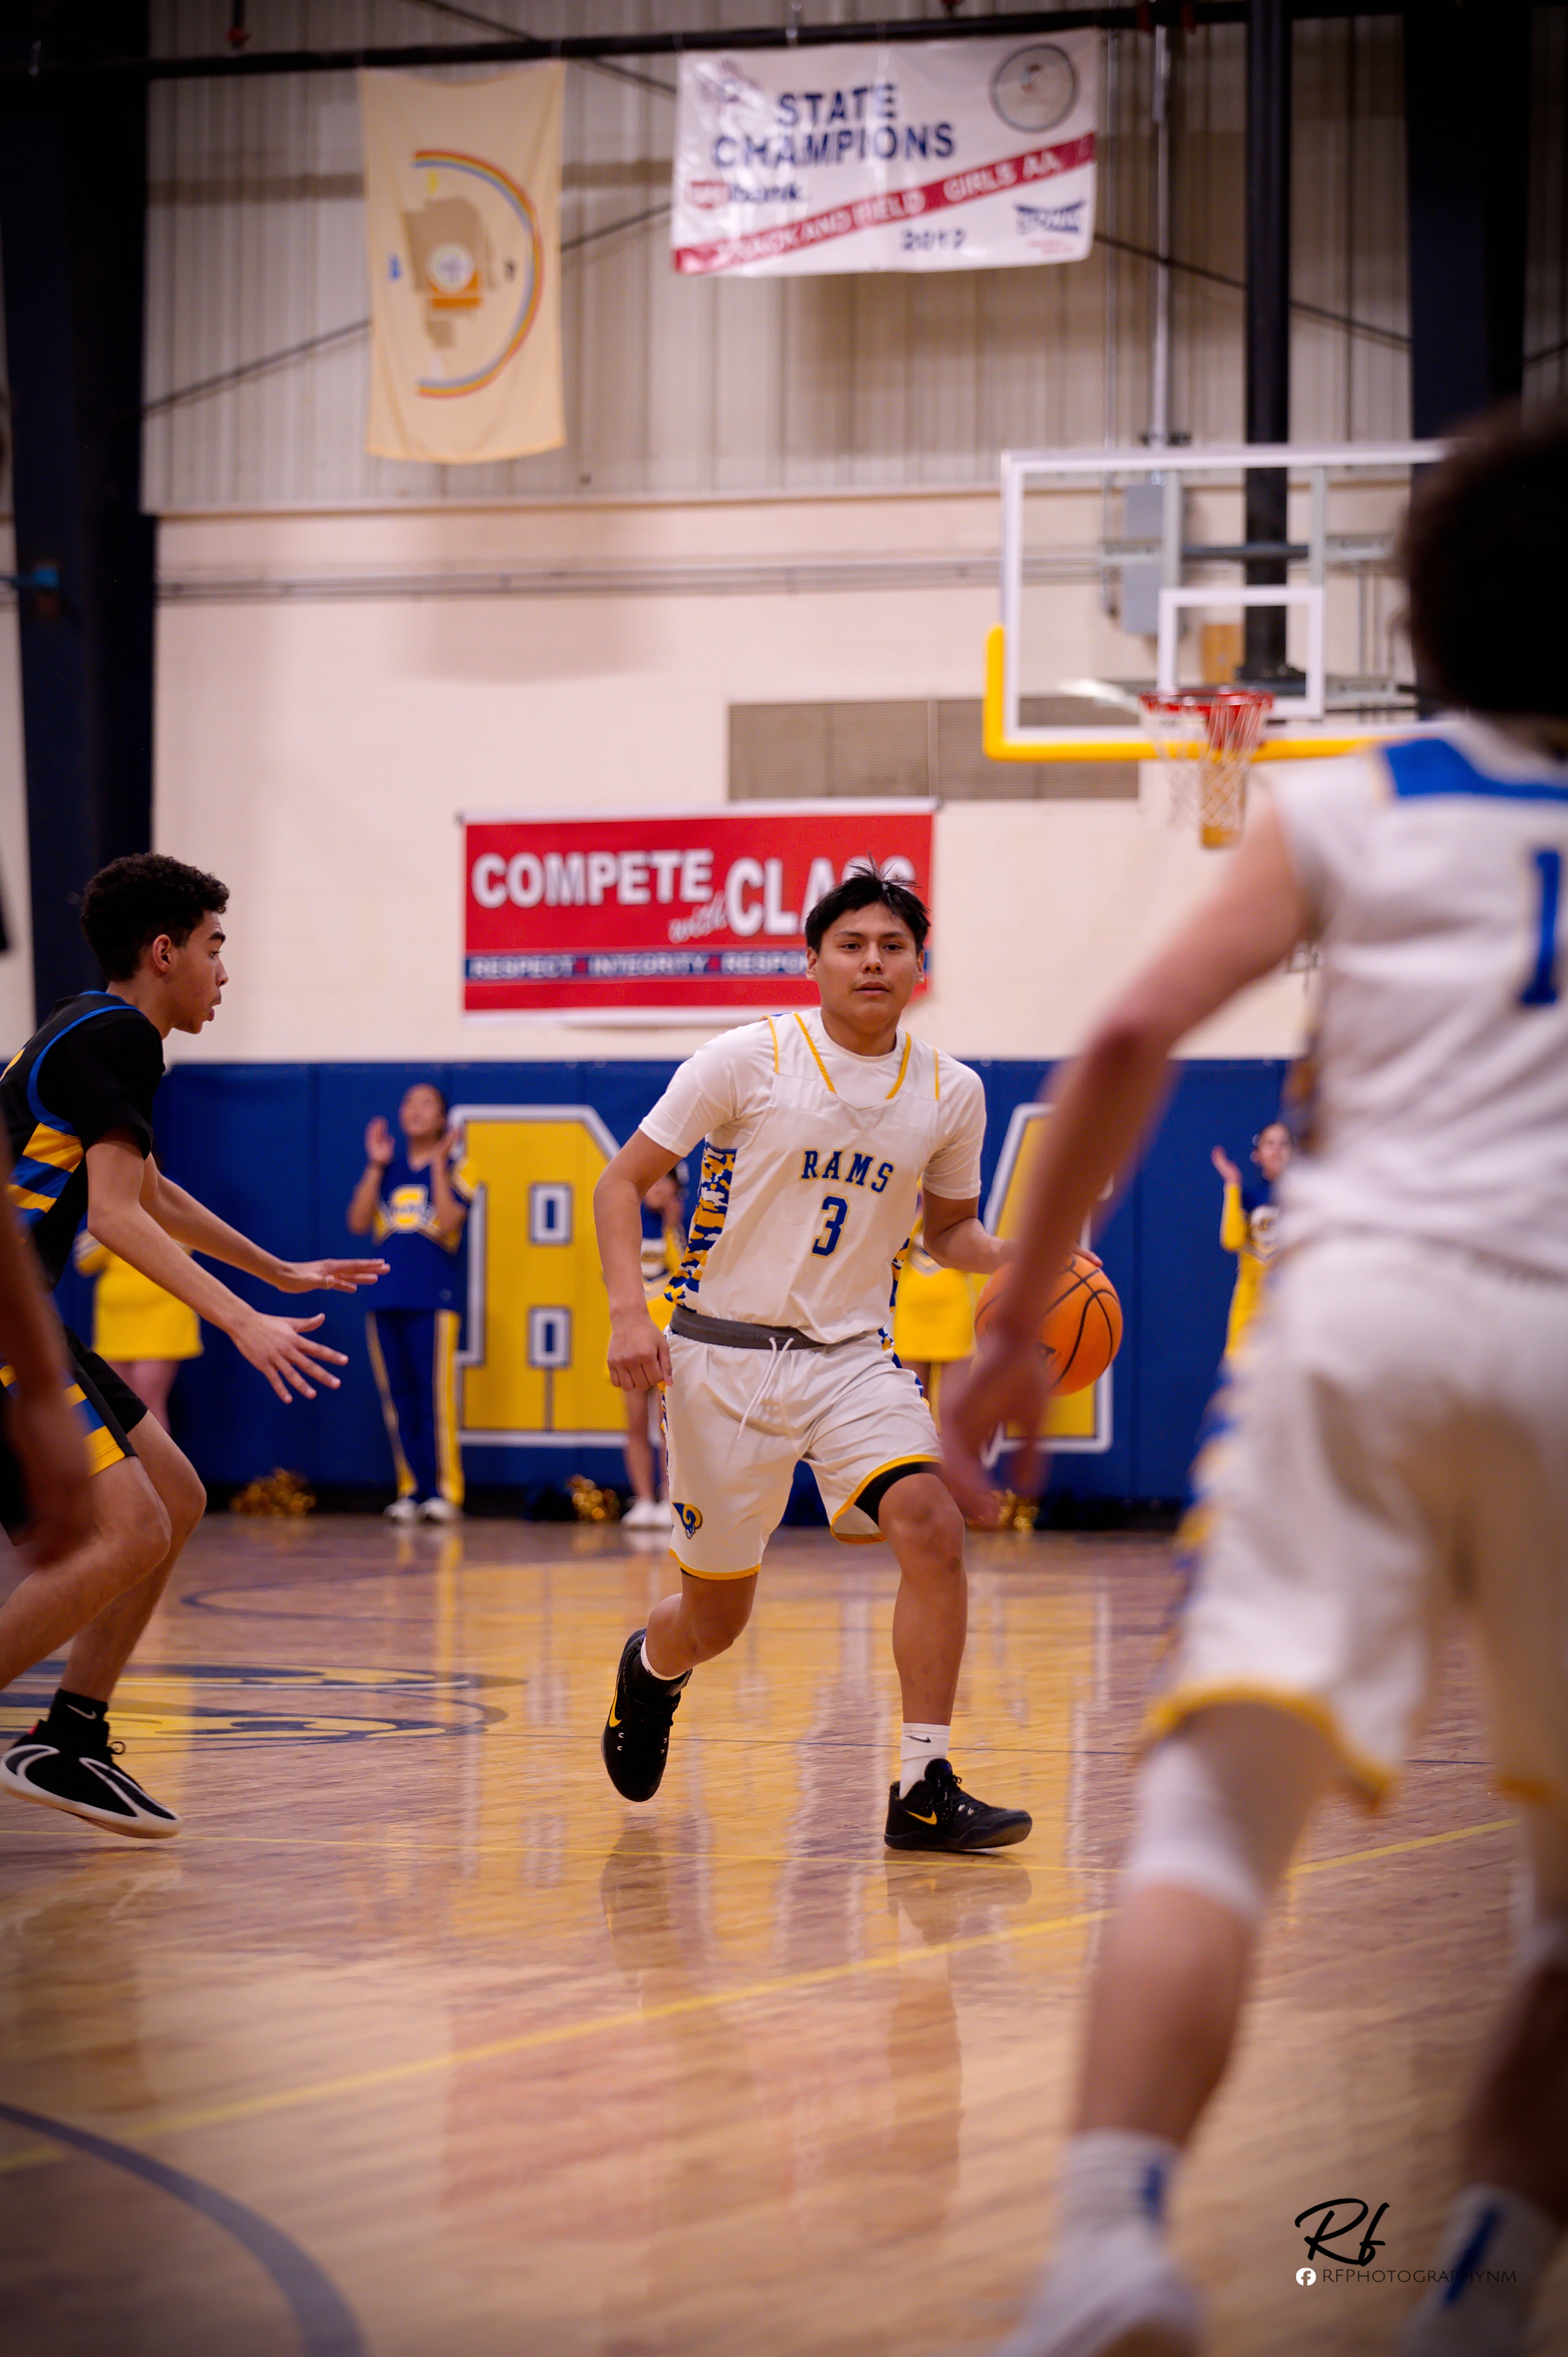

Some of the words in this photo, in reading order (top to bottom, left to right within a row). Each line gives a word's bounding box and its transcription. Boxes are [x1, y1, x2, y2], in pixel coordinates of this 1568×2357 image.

[776, 81, 899, 129] STATE
[712, 121, 958, 170] CHAMPIONS
[472, 848, 713, 909] COMPETE
[799, 1148, 894, 1194] RAMS
[811, 1193, 850, 1258] 3
